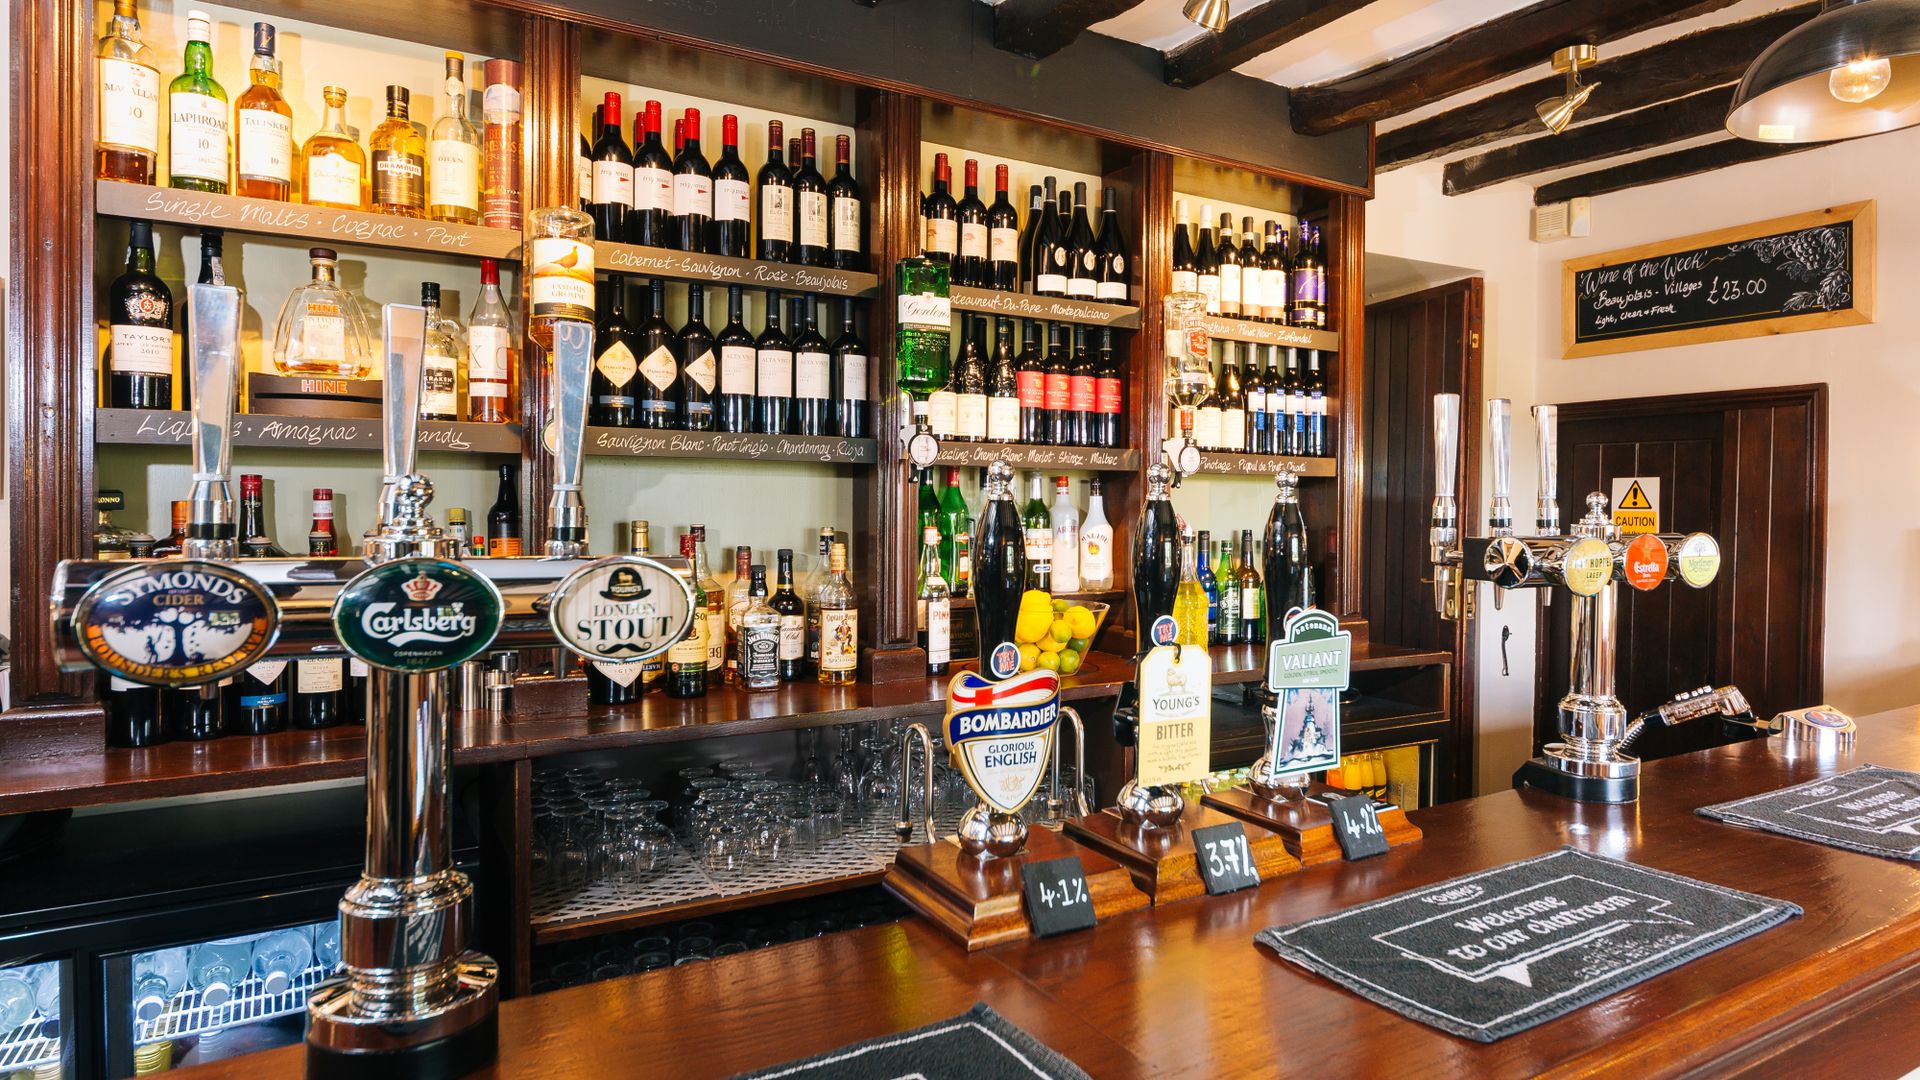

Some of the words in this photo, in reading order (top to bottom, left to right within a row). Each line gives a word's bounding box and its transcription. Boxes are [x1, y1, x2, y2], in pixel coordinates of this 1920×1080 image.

[245, 117, 289, 133] TALISKER
[145, 192, 230, 222] Single
[241, 204, 308, 229] Malts
[332, 215, 407, 240] Cognac
[425, 227, 473, 247] Port
[795, 270, 848, 291] Beaujolais
[1622, 264, 1637, 286] of
[1640, 260, 1658, 280] the
[1663, 279, 1703, 302] Villages
[308, 303, 340, 315] HINE
[1051, 304, 1110, 320] Montepulciano
[122, 333, 171, 344] TAYLOR'S
[301, 379, 347, 393] HINE
[597, 433, 666, 453] Sauvignon
[670, 434, 704, 451] Blanc
[712, 435, 740, 452] Pinot
[740, 437, 768, 458] Grigio
[777, 439, 832, 461] Chardonnay
[837, 440, 864, 461] Rioja
[1027, 449, 1055, 464] Merlot
[1090, 453, 1119, 466] Malbec
[1616, 516, 1655, 527] CAUTION
[1634, 562, 1659, 573] Estrella
[121, 571, 247, 606] SYMONDS
[611, 586, 641, 594] YOUNG'S
[153, 594, 204, 606] CIDER
[594, 603, 655, 617] LONDON
[361, 601, 476, 642] Carlsberg
[577, 616, 673, 641] STOUT
[1157, 622, 1174, 636] TRY
[748, 633, 762, 645] JACK
[1158, 632, 1173, 644] ME
[996, 649, 1015, 663] TRY
[1282, 650, 1342, 670] VALIANT
[998, 661, 1015, 673] ME
[1153, 696, 1200, 711] YOUNG'S
[960, 703, 1056, 735] BOMBARDIER
[1156, 722, 1194, 741] BITTER
[988, 741, 1035, 754] GLORIOUS
[985, 751, 1037, 768] ENGLISH
[1453, 894, 1568, 933] Welcome
[1446, 940, 1484, 960] to
[1482, 929, 1532, 953] our
